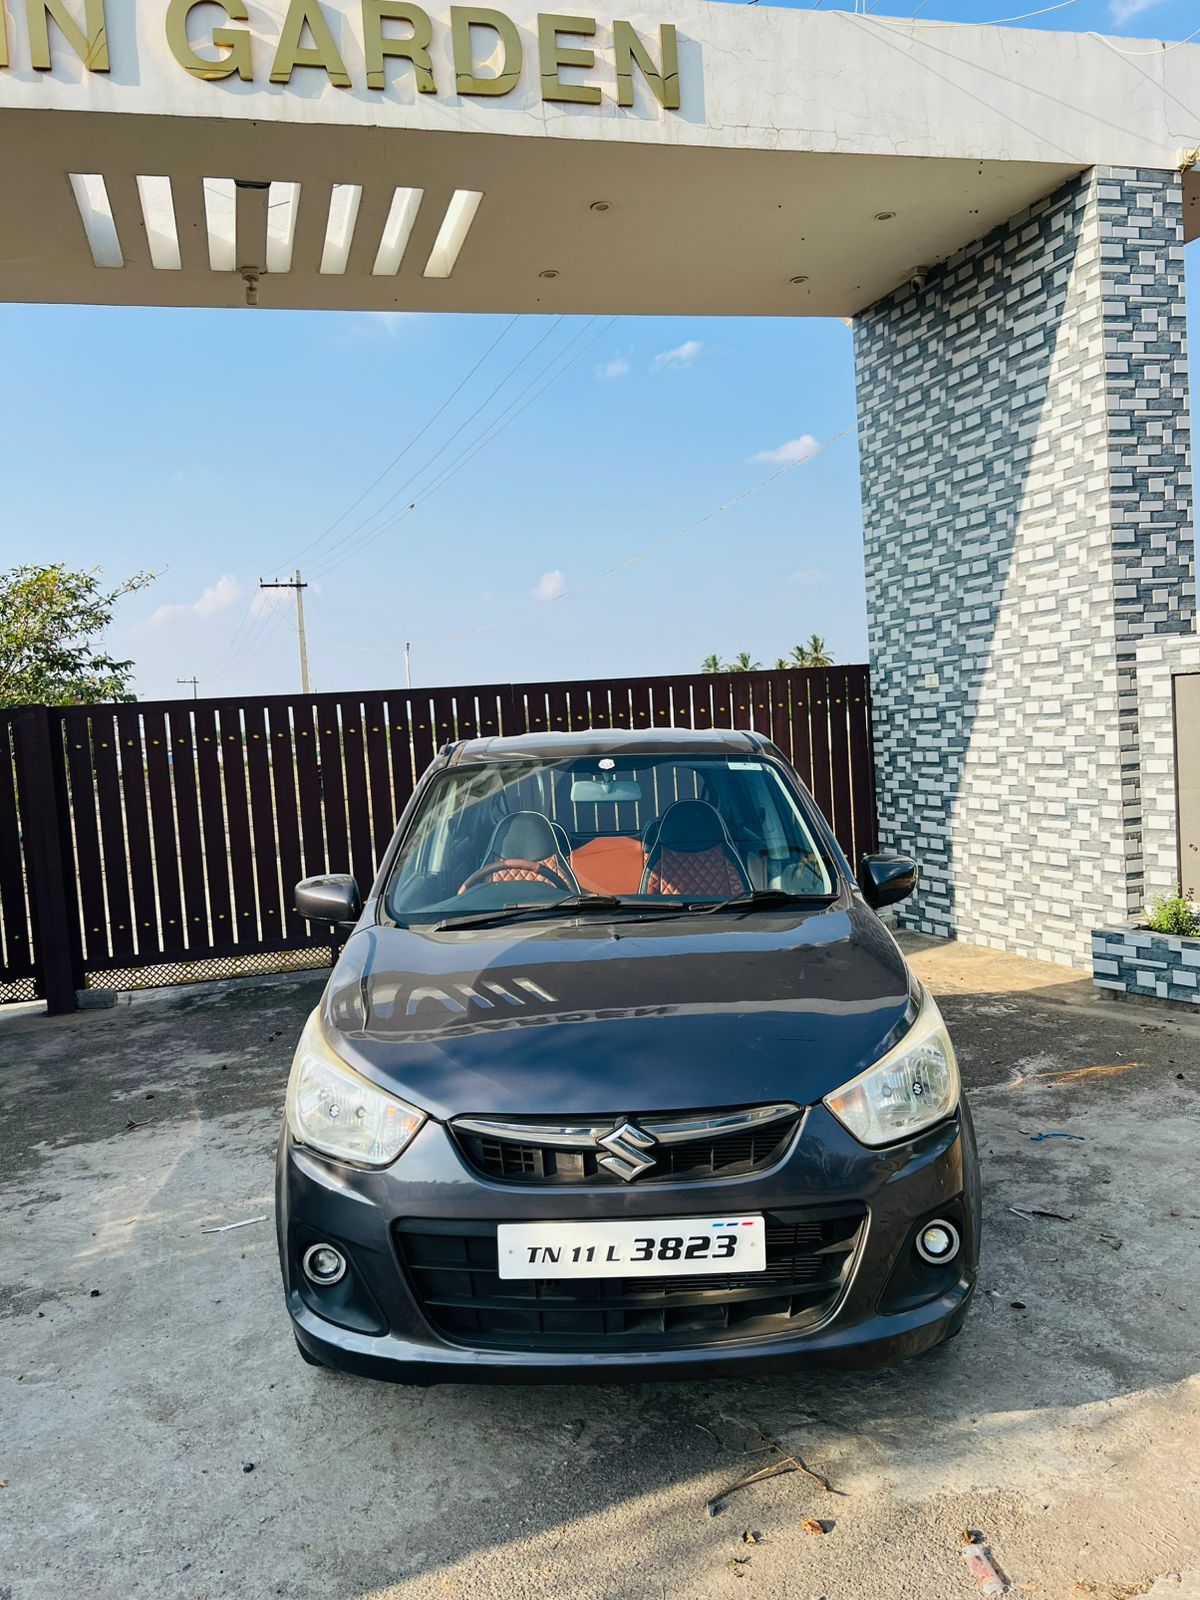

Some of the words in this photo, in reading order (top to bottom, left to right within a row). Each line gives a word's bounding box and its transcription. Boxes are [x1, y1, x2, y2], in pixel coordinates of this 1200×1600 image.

[165, 0, 681, 110] GARDEN
[527, 1246, 562, 1263] TN
[572, 1246, 597, 1263] 11
[606, 1245, 621, 1262] L
[630, 1234, 738, 1261] 3823
